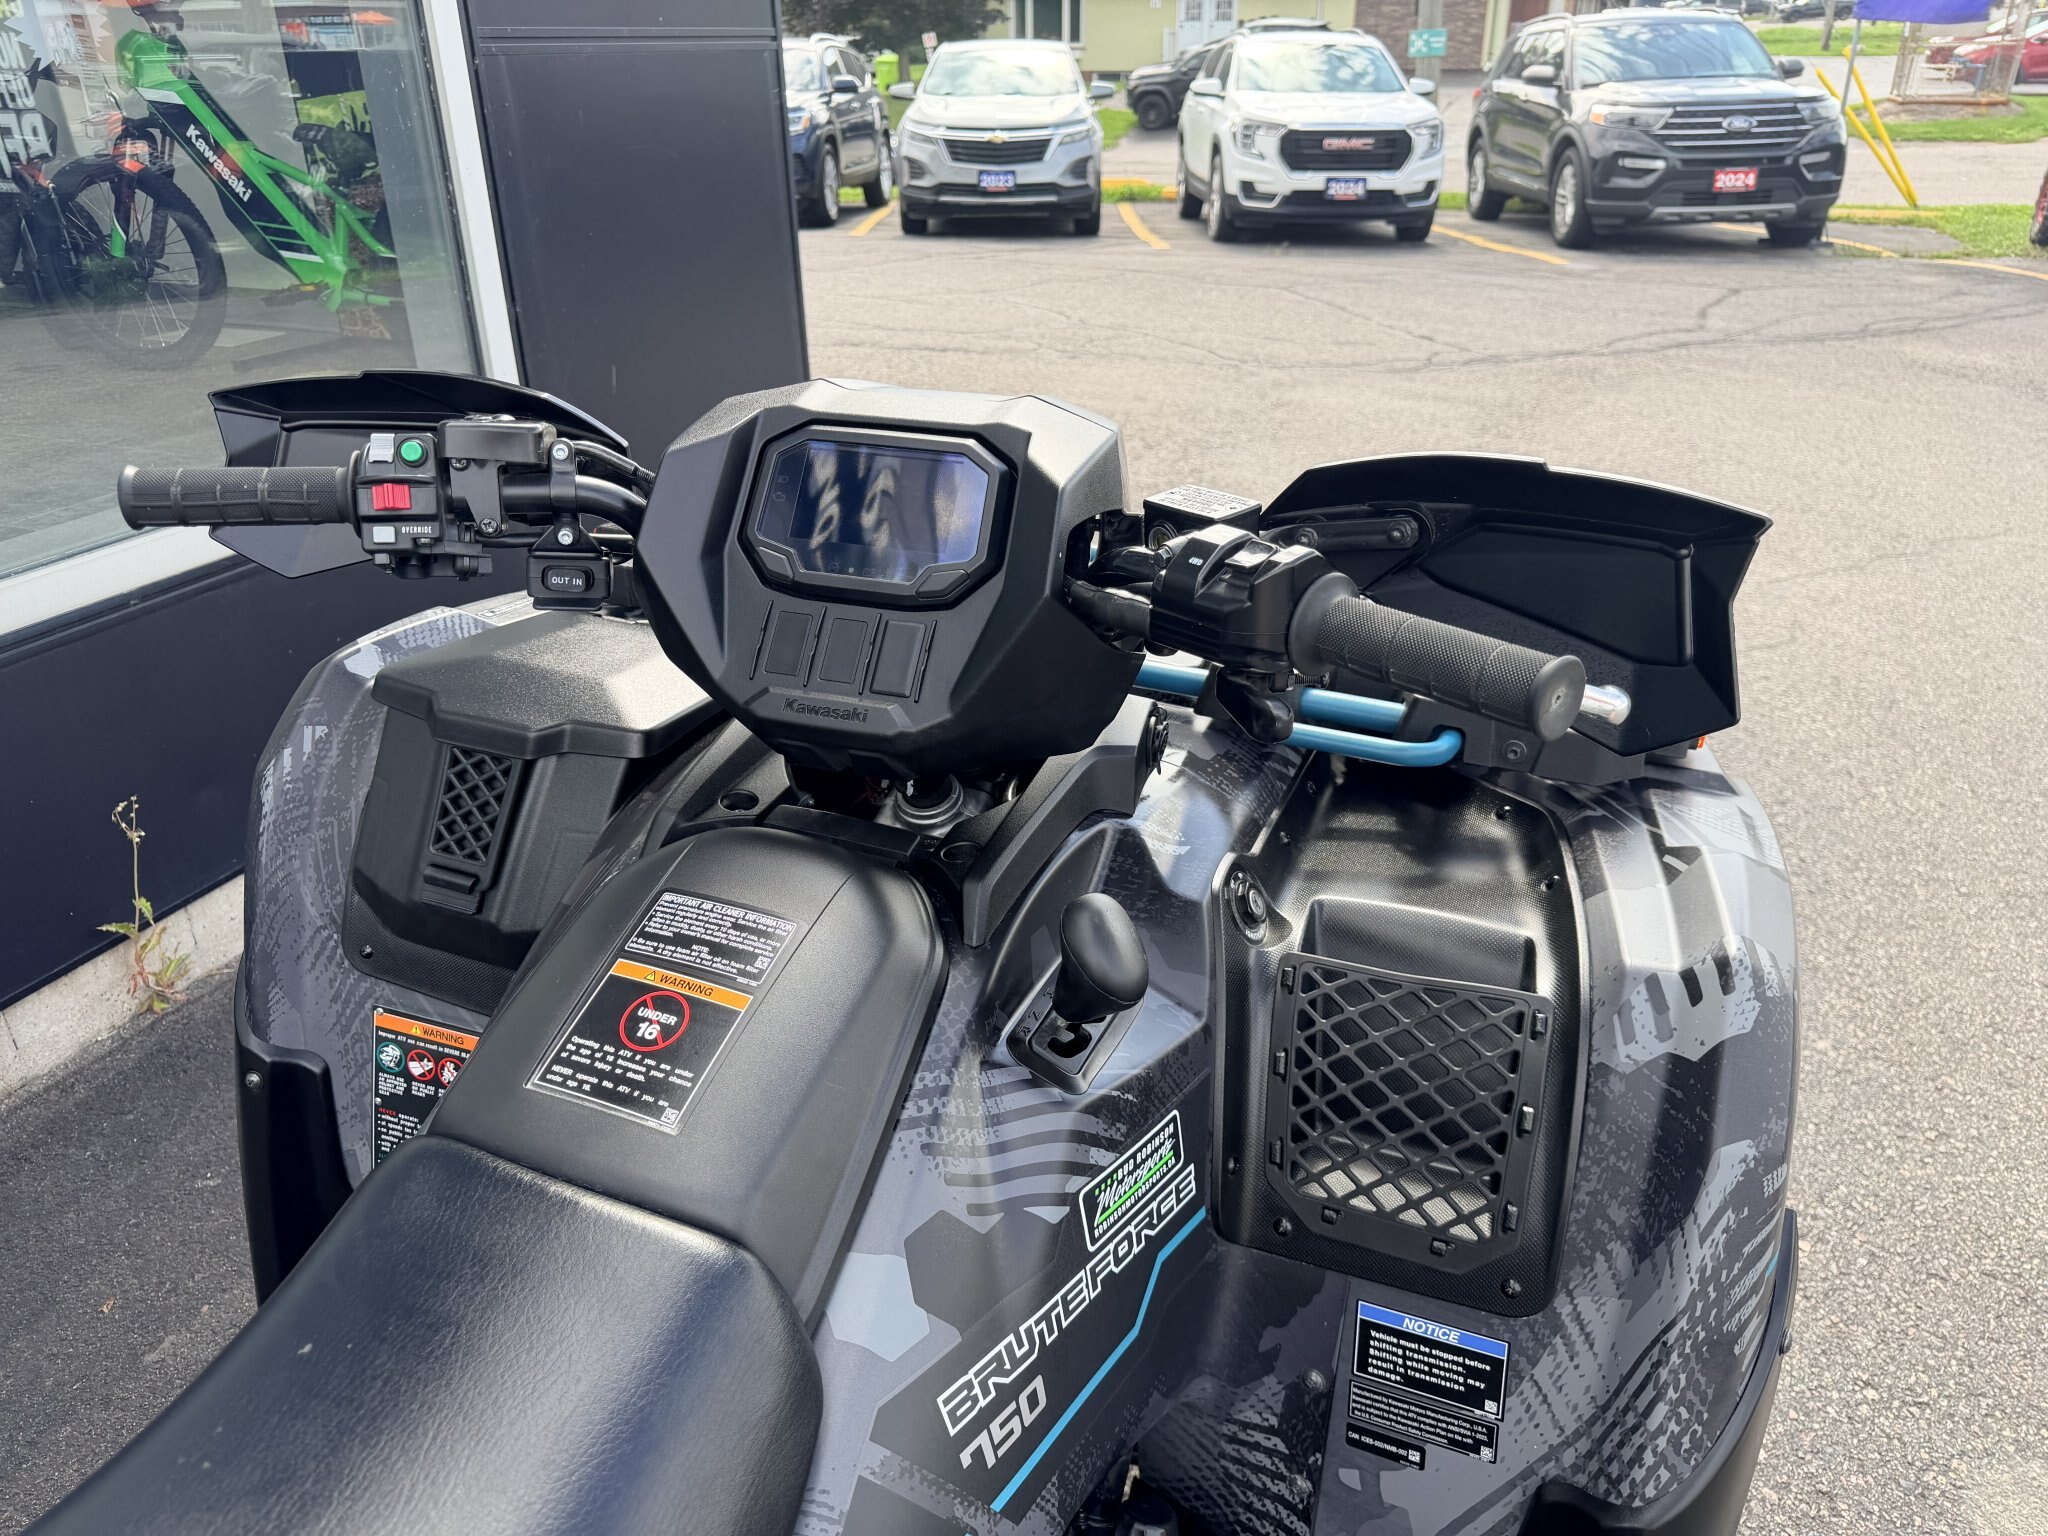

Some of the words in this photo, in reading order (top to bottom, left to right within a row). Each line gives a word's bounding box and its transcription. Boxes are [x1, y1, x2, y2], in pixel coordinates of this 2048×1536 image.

[1322, 137, 1376, 151] GMC
[186, 124, 252, 202] Kawasaki
[980, 172, 1015, 187] 2023
[1327, 181, 1365, 195] 2024
[1715, 173, 1755, 188] 2024
[402, 526, 432, 534] OVERRIDE
[1188, 557, 1204, 566] 4WD
[552, 576, 569, 585] OUT
[572, 578, 583, 587] IN
[783, 697, 869, 724] Kawasaki
[663, 894, 699, 907] IMPORTANT
[700, 902, 713, 911] AIR
[713, 906, 745, 918] CLEANER
[744, 914, 793, 931] INFORMATION
[660, 974, 714, 996] WARNING
[637, 1007, 677, 1025] UNDER
[423, 1027, 464, 1044] WARNING
[636, 1022, 660, 1040] 16
[566, 1043, 576, 1051] the
[616, 1058, 646, 1072] increases
[649, 1069, 665, 1078] your
[668, 1076, 692, 1087] chance
[570, 1054, 591, 1064] severe
[594, 1060, 612, 1071] injury
[626, 1071, 645, 1082] death.
[571, 1035, 600, 1049] Operating
[603, 1045, 615, 1053] this
[618, 1049, 633, 1058] ATV
[643, 1058, 656, 1066] you
[674, 1068, 694, 1078] under
[546, 1073, 563, 1082] under
[566, 1079, 578, 1087] age
[582, 1083, 591, 1091] 16.
[551, 1064, 573, 1075] NEVER
[575, 1073, 598, 1083] operate
[601, 1080, 614, 1088] this
[616, 1085, 631, 1093] ATV
[641, 1094, 655, 1102] you
[1118, 1160, 1134, 1180] BUD
[1137, 1122, 1174, 1164] ROBINSON
[1094, 1138, 1175, 1228] Motorsports
[1094, 1156, 1175, 1238] ROBINSONMOTORSPORTS.CA
[937, 1163, 1196, 1437] BRUTEFORCE
[1402, 1318, 1460, 1343] NOTICE
[1370, 1329, 1398, 1343] Vehicle
[1399, 1339, 1418, 1350] must
[1420, 1344, 1430, 1353] be
[1431, 1349, 1463, 1363] stopped
[1465, 1358, 1490, 1371] before
[1370, 1340, 1403, 1355] shifting
[1406, 1350, 1466, 1373] transmission.
[1367, 1366, 1403, 1382] damage.
[1368, 1358, 1393, 1370] result
[1396, 1365, 1404, 1373] in
[1407, 1369, 1464, 1391] transmission
[1369, 1348, 1403, 1365] Shifting
[1406, 1360, 1429, 1371] while
[1432, 1368, 1464, 1383] moving
[1467, 1378, 1485, 1389] may
[960, 1374, 1047, 1470] 750
